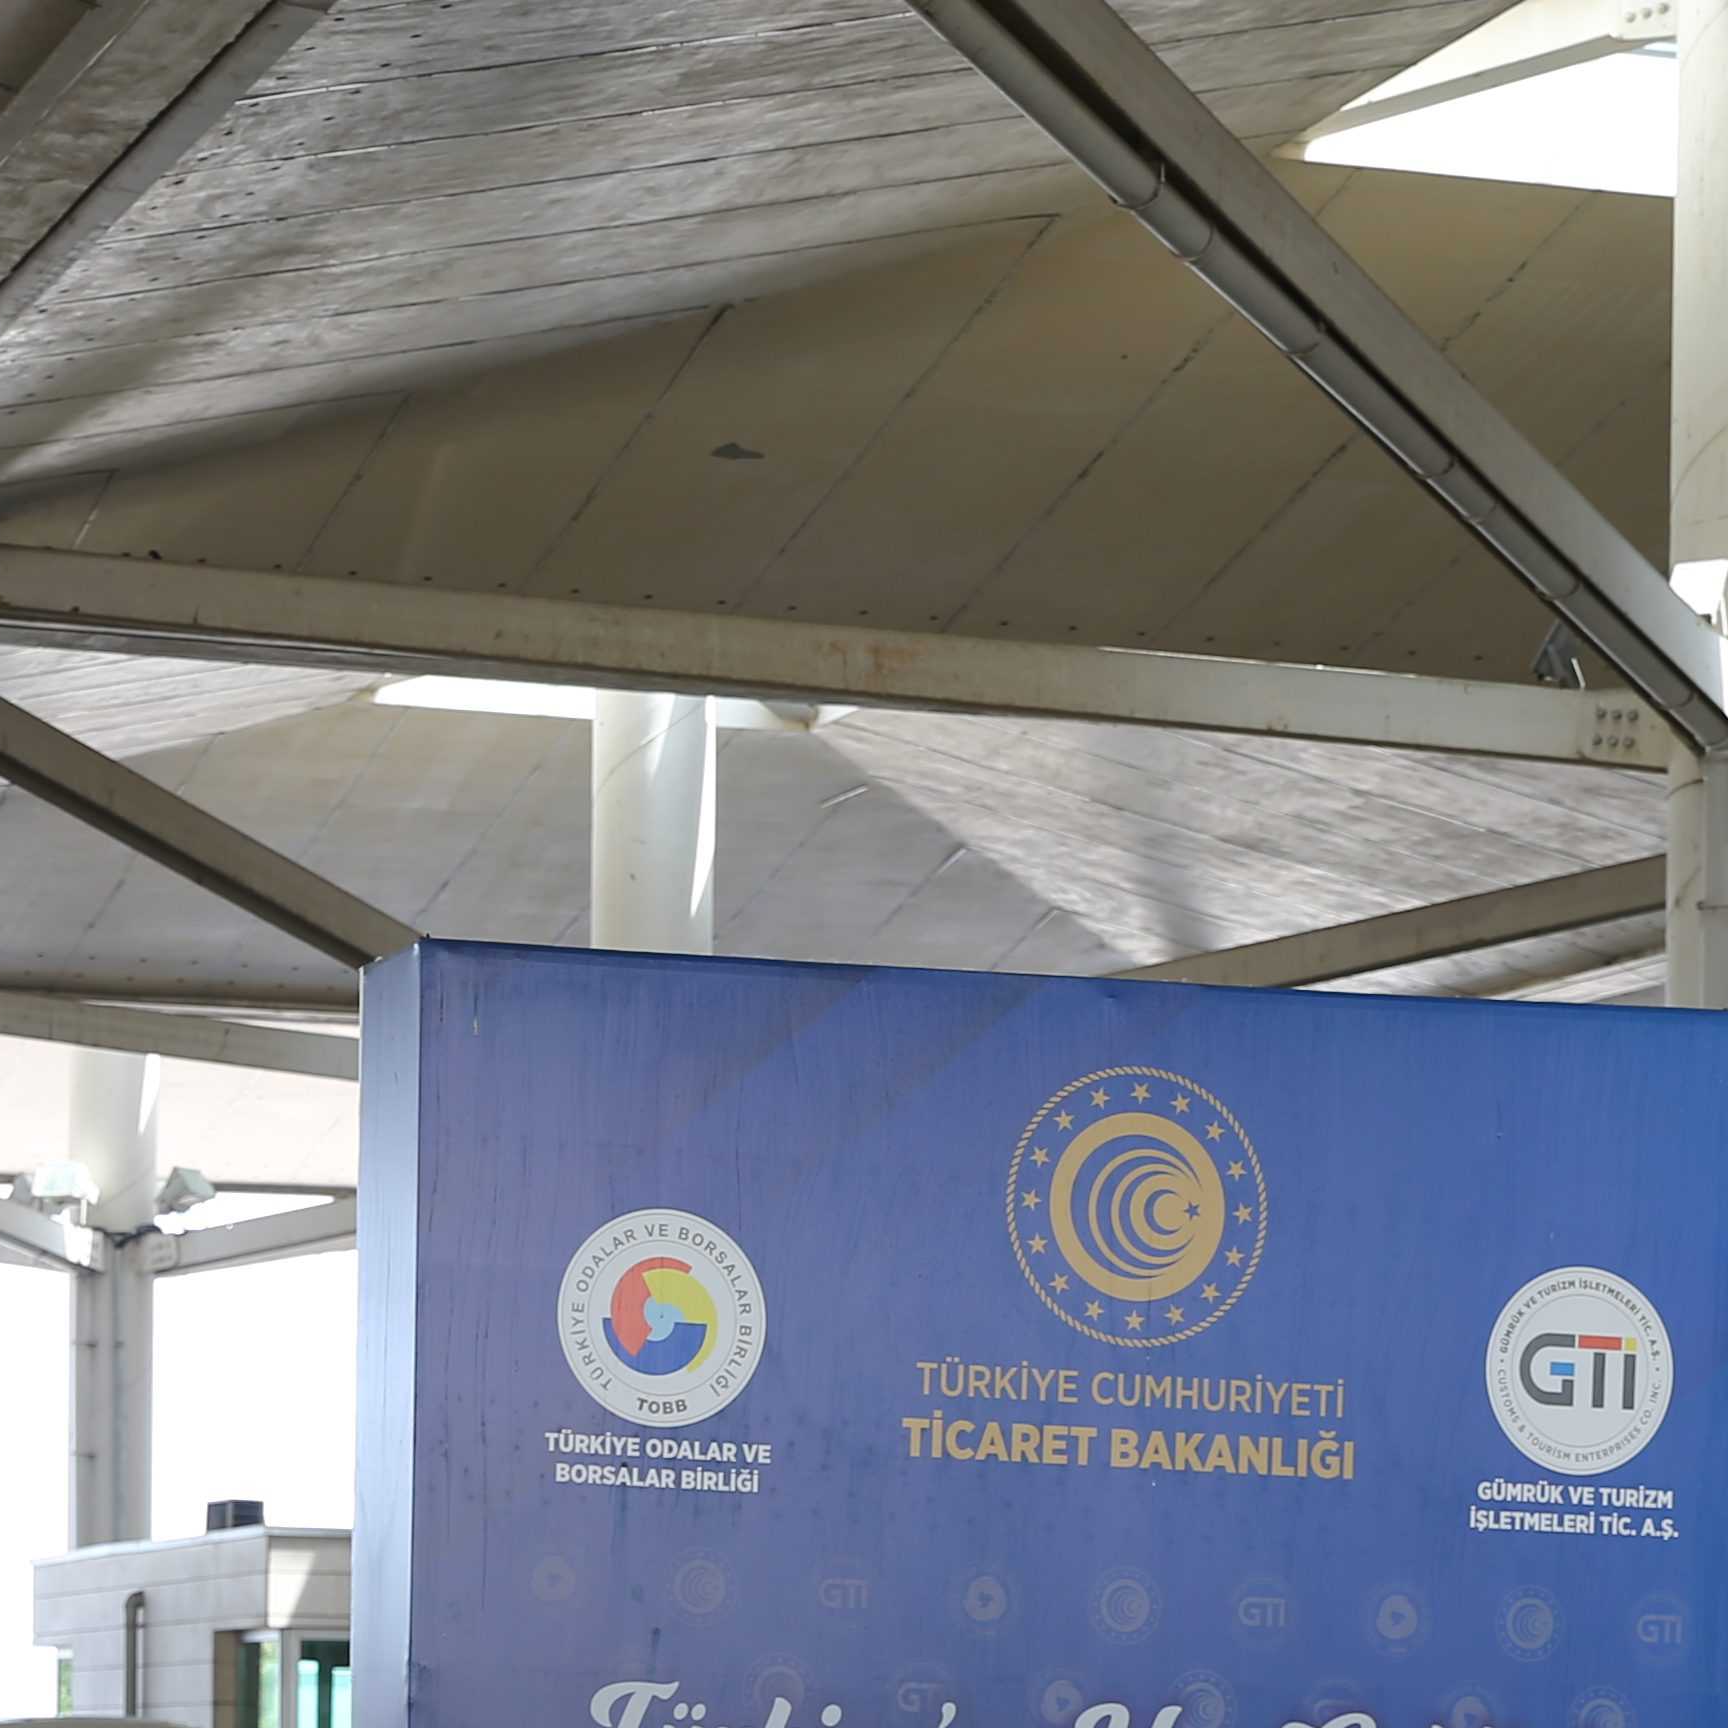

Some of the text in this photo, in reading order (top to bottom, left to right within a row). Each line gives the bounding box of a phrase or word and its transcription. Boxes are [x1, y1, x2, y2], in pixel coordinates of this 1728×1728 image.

[576, 1229, 637, 1293] ODALAR
[644, 1224, 669, 1237] VE
[678, 1227, 752, 1316] BORSALAR
[1524, 1295, 1537, 1309] VE
[916, 1356, 1344, 1419] TÜRKİYE CUMHURİYETİ
[1497, 1369, 1521, 1424] CUSTOMS
[637, 1397, 688, 1415] TOBB
[544, 1429, 772, 1464] TÜRKİYE ODALAR VE
[901, 1409, 1355, 1480] TİCARET BAKANLIĞI
[555, 1463, 759, 1493] BORSALAR BİRLİĞİ
[1477, 1478, 1673, 1509] GÜMRÜK VE TURİZM
[1469, 1505, 1679, 1541] İŞLETMELERİ TİC. A.Ş.
